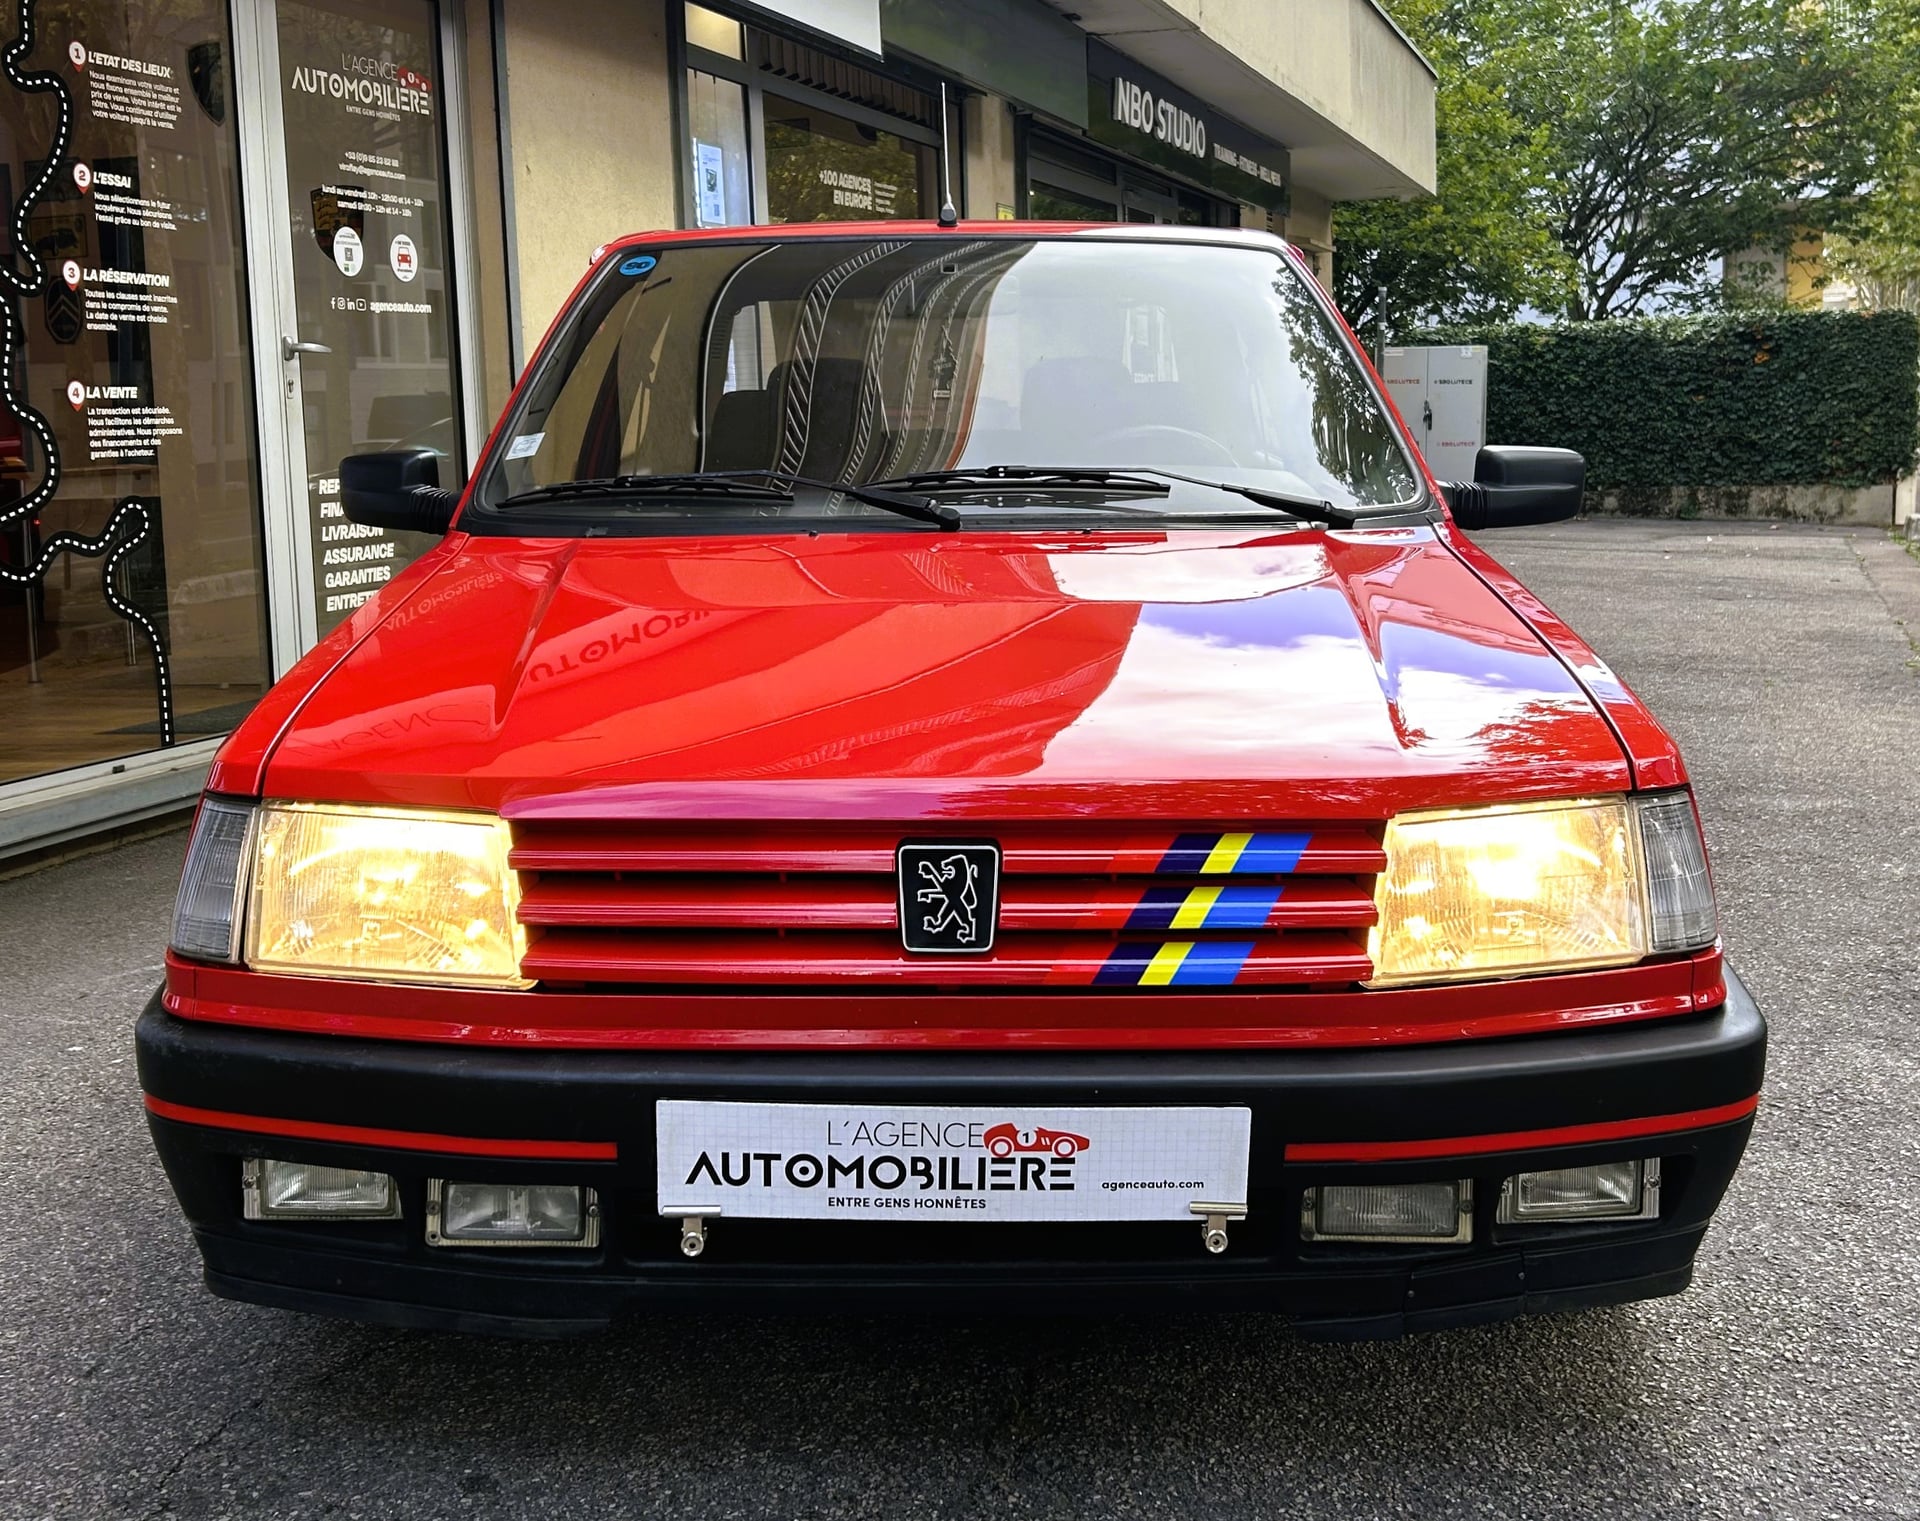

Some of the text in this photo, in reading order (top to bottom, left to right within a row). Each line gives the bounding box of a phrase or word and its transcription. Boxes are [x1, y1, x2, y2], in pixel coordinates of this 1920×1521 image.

[74, 48, 81, 58] 1
[88, 51, 171, 78] L'ETAT DES LIEUX
[89, 70, 105, 80] Nous
[90, 81, 105, 90] nous
[90, 90, 103, 99] prix
[103, 92, 112, 101] de
[109, 102, 125, 112] Vous
[92, 110, 109, 119] votre
[1113, 76, 1207, 159] NBO STUDIO
[79, 170, 86, 181] 2
[93, 171, 131, 189] L'ESSAI
[819, 169, 838, 187] +100
[838, 172, 872, 194] AGENCES
[94, 192, 110, 201] Nous
[833, 190, 844, 206] EN
[844, 191, 873, 211] EUROPE
[126, 206, 142, 216] Nous
[140, 218, 152, 228] bon
[152, 220, 160, 229] de
[68, 267, 76, 278] 3
[83, 268, 170, 287] LA RÉSERVATION
[84, 288, 105, 298] Toutes
[105, 290, 116, 299] les
[138, 293, 153, 302] sont
[85, 299, 101, 309] dans
[142, 303, 151, 312] de
[370, 302, 432, 314] agenceauto.com
[85, 311, 94, 320] La
[94, 312, 109, 320] date
[109, 312, 118, 321] de
[118, 314, 136, 322] vente
[72, 388, 80, 399] 4
[86, 386, 138, 399] LA VENTE
[87, 407, 95, 415] La
[96, 407, 130, 415] transaction
[131, 407, 141, 415] est
[88, 417, 104, 426] Nous
[133, 418, 142, 426] les
[136, 427, 152, 436] Nous
[89, 439, 101, 448] des
[150, 437, 161, 446] des
[322, 523, 384, 542] LIVRAISON
[323, 543, 394, 566] ASSURANCE
[325, 565, 391, 588] GARANTIES
[827, 1120, 985, 1148] L'AGENCE
[1022, 1132, 1029, 1144] 1
[1101, 1179, 1205, 1191] agenceauto.com
[827, 1195, 987, 1210] ENTRE GENS HONNÊTES
